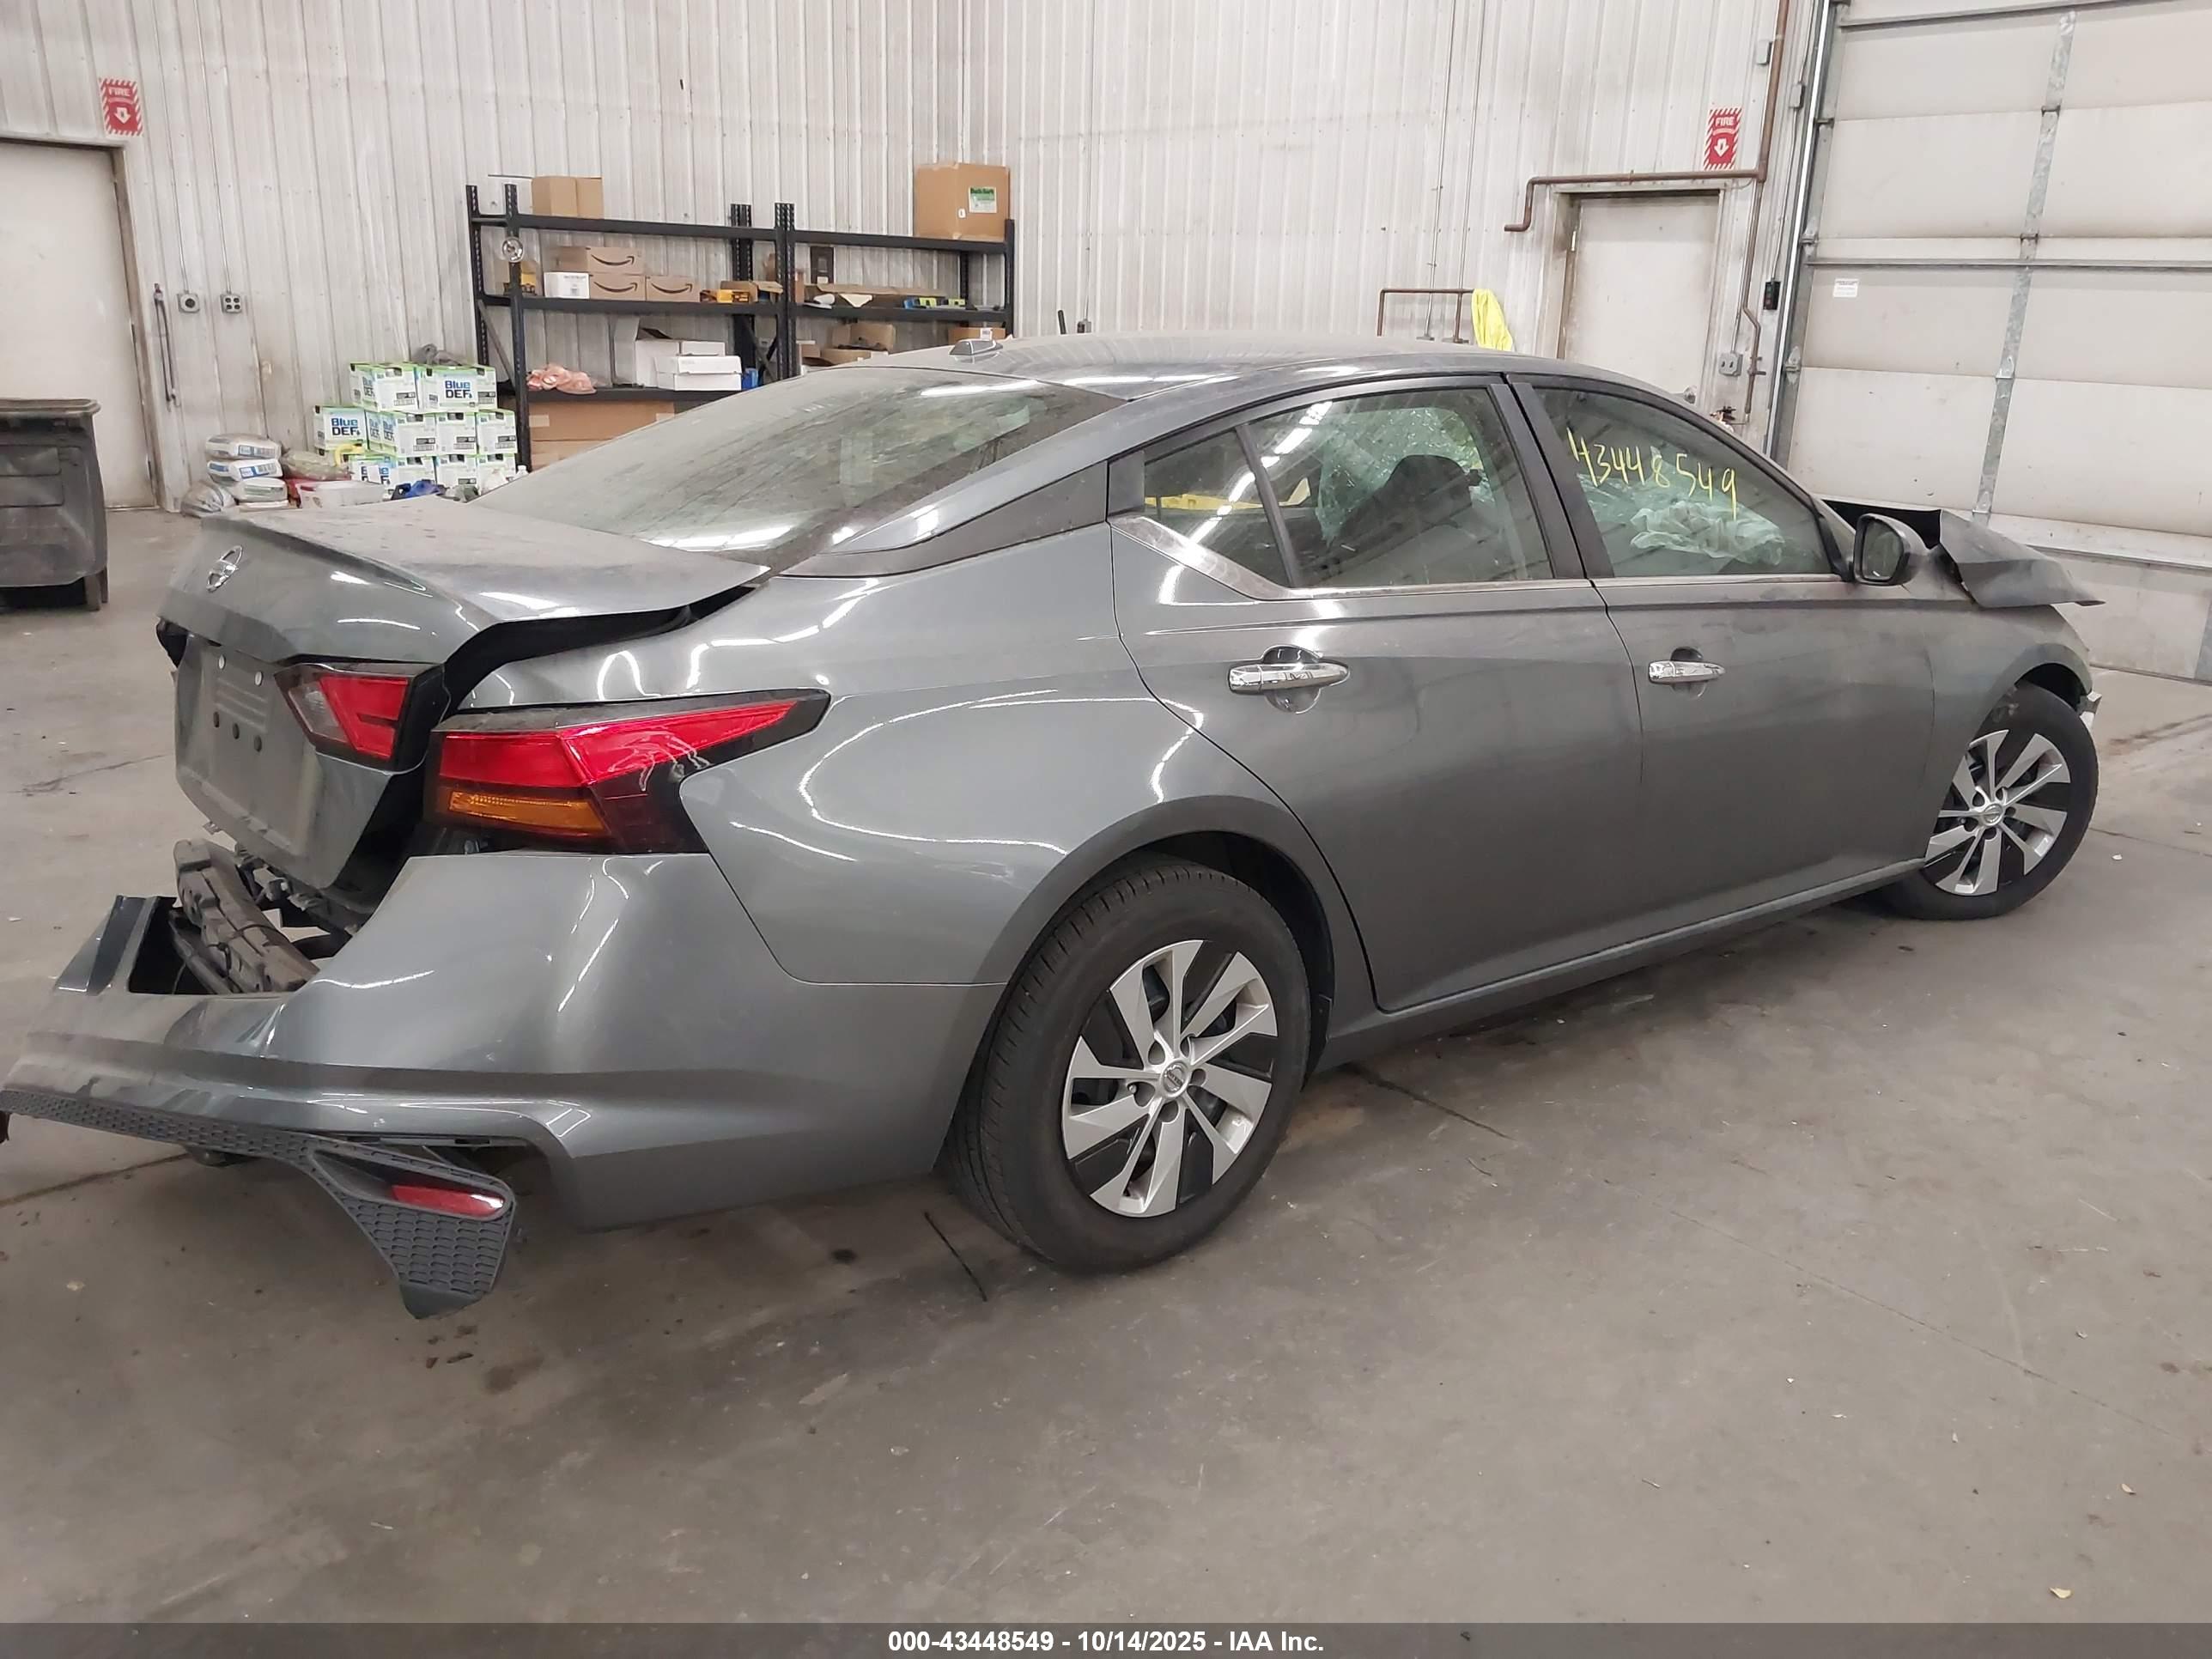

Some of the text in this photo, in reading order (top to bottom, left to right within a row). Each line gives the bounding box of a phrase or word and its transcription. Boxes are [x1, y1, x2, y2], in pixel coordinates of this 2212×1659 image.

[108, 87, 131, 97] FIRE
[1715, 116, 1735, 127] FIRE
[445, 380, 471, 390] Blue
[446, 389, 471, 399] DEF
[331, 417, 358, 427] Blue
[331, 426, 359, 436] DEF
[1565, 426, 1738, 522] 43448549
